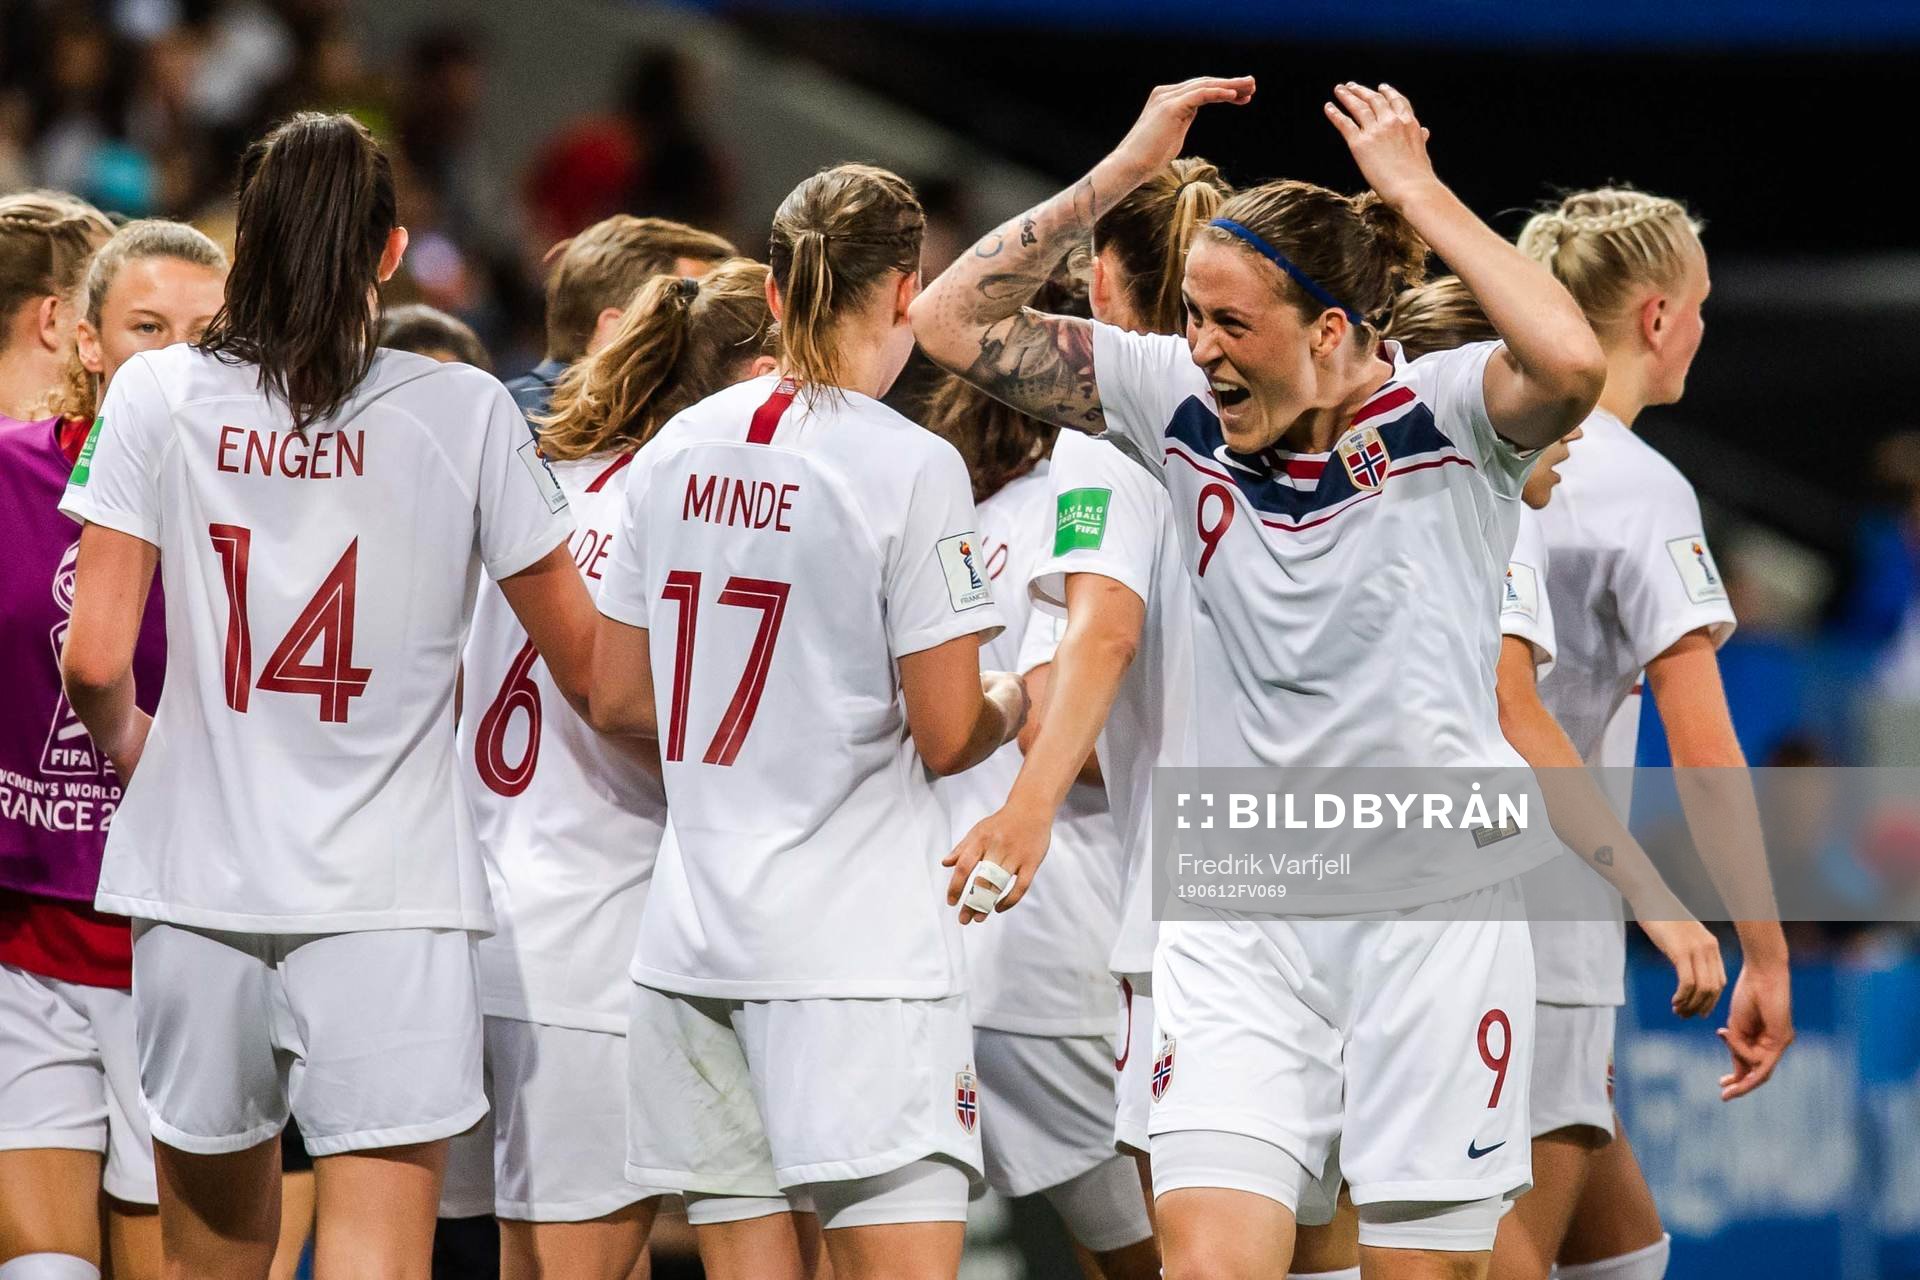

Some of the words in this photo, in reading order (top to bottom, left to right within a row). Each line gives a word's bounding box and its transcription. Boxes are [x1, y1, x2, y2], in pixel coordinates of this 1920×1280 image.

[217, 425, 365, 479] ENGEN
[682, 474, 799, 532] MINDE
[1058, 512, 1101, 526] FOOTBALL
[1059, 505, 1104, 518] LIVING
[1075, 524, 1100, 536] FIFA
[1197, 483, 1235, 574] 9
[567, 528, 613, 580] DE
[208, 523, 373, 723] 14
[661, 570, 791, 767] 17
[474, 640, 543, 797] 6
[51, 749, 92, 767] FIFA
[64, 783, 121, 800] WORLD
[1476, 1008, 1512, 1108] 9
